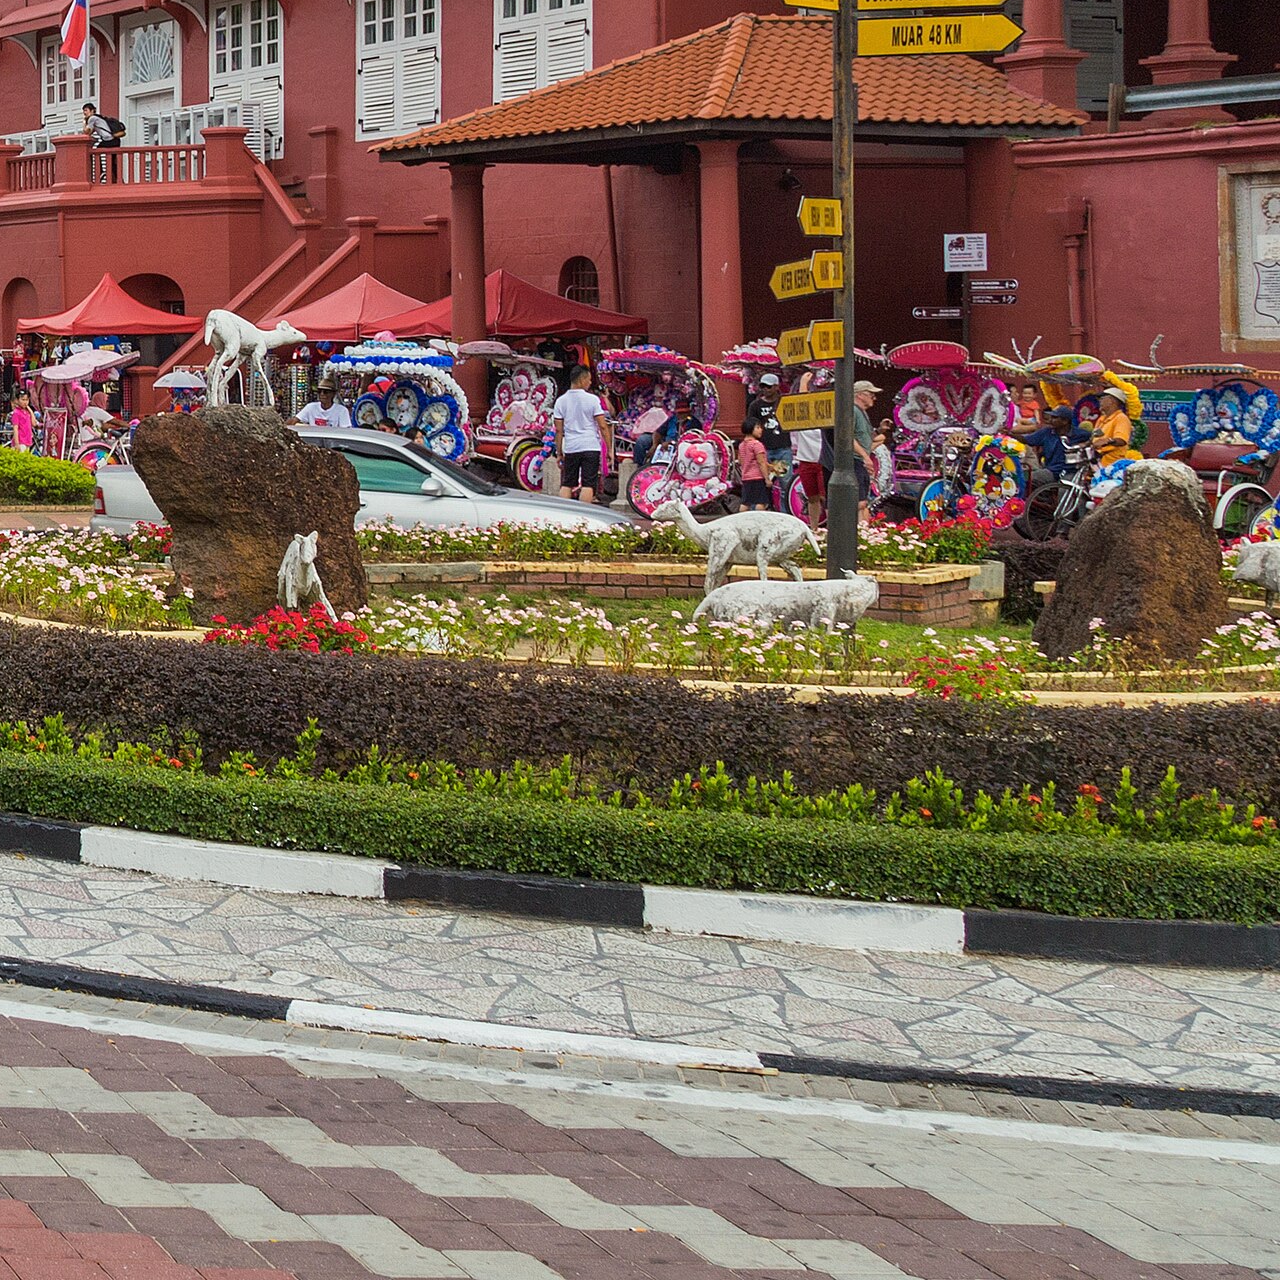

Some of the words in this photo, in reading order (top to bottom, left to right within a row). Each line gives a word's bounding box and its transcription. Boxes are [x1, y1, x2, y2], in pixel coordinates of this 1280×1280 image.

[892, 25, 923, 46] MUAR
[929, 24, 942, 45] 48
[945, 23, 962, 44] KM
